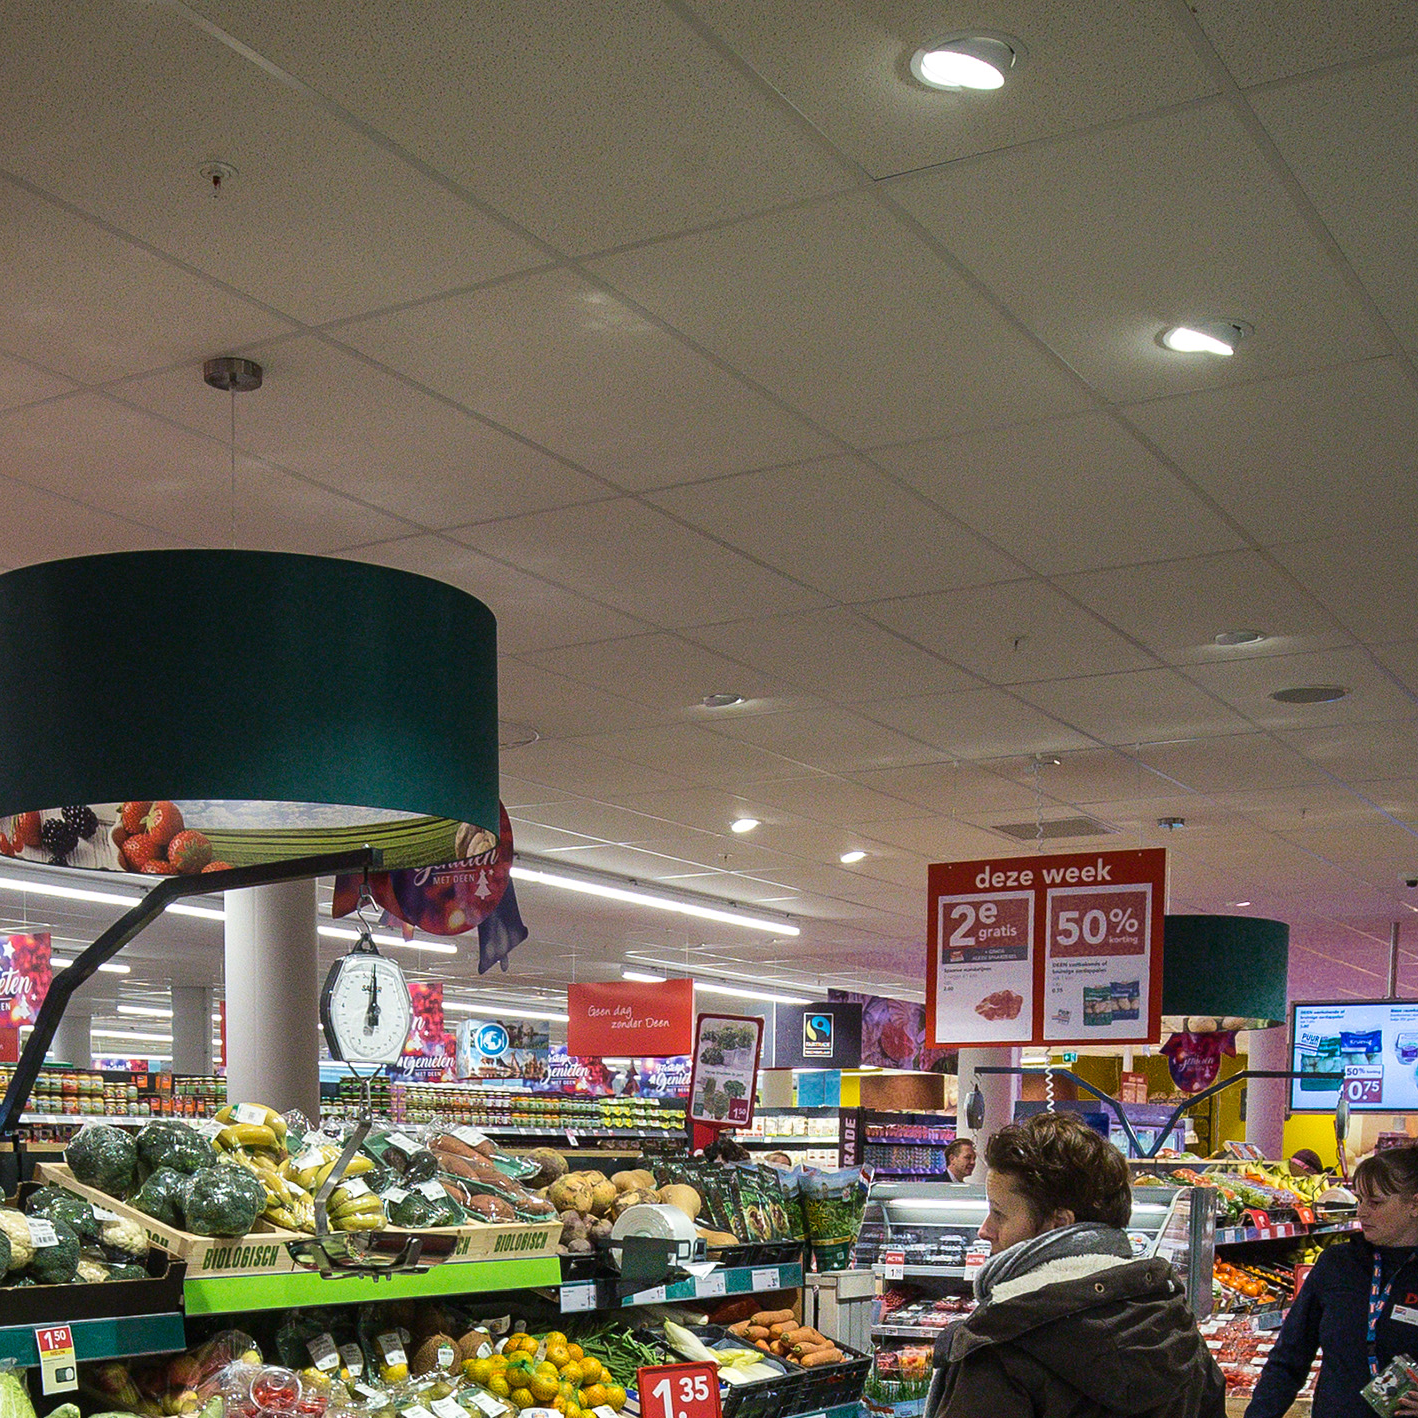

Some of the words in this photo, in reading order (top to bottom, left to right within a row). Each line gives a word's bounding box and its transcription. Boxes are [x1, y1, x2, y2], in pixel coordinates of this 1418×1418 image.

[433, 875, 451, 885] MET
[453, 873, 475, 884] DEEN
[975, 866, 1033, 888] deze
[1042, 858, 1112, 884] week
[979, 924, 1017, 941] gratis
[1057, 908, 1139, 946] 50%
[1109, 935, 1139, 944] korting
[362, 984, 382, 993] SALER
[588, 1005, 611, 1016] Geen
[613, 1005, 632, 1019] dag
[611, 1018, 643, 1029] zonder
[645, 1018, 670, 1028] Deen
[1302, 1033, 1319, 1042] PUUR
[404, 1055, 455, 1077] Genieten
[1346, 1067, 1365, 1076] 50%
[1348, 1081, 1380, 1100] 0.75
[844, 1118, 856, 1168] RADE
[494, 1232, 548, 1253] BIOLOGISCH
[203, 1245, 279, 1270] BIOLOGISCH
[44, 1330, 66, 1350] 1.50
